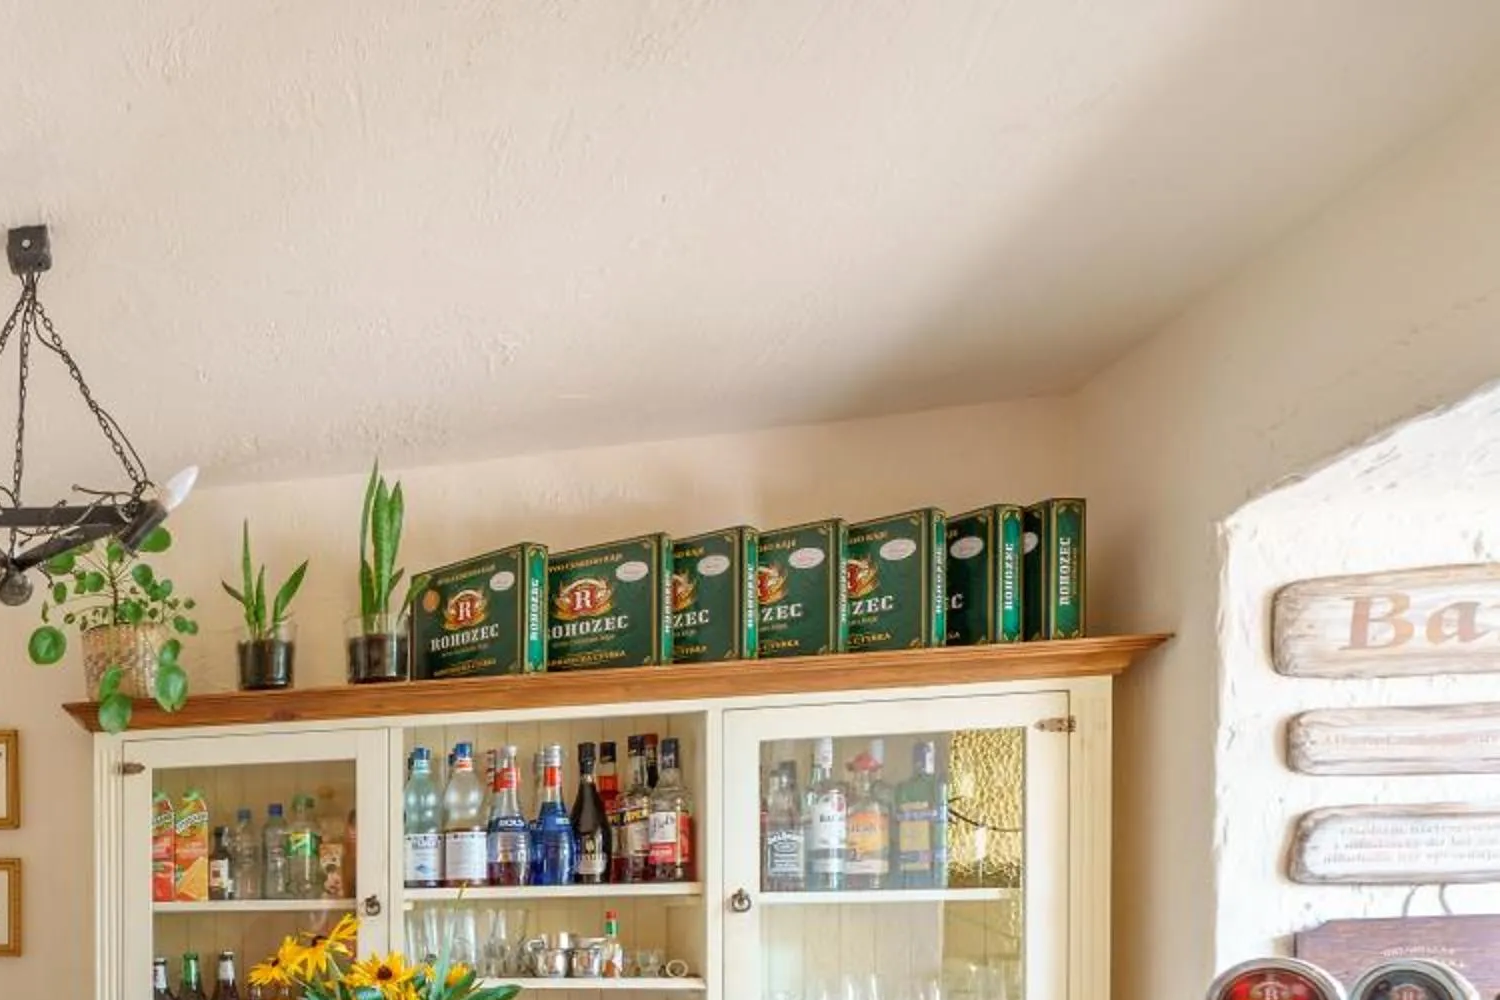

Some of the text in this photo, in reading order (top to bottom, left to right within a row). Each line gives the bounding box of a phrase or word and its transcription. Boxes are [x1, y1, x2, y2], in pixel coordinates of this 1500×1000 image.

[573, 588, 593, 612] R
[1338, 591, 1500, 650] Ba
[430, 622, 499, 651] ROHOZEC
